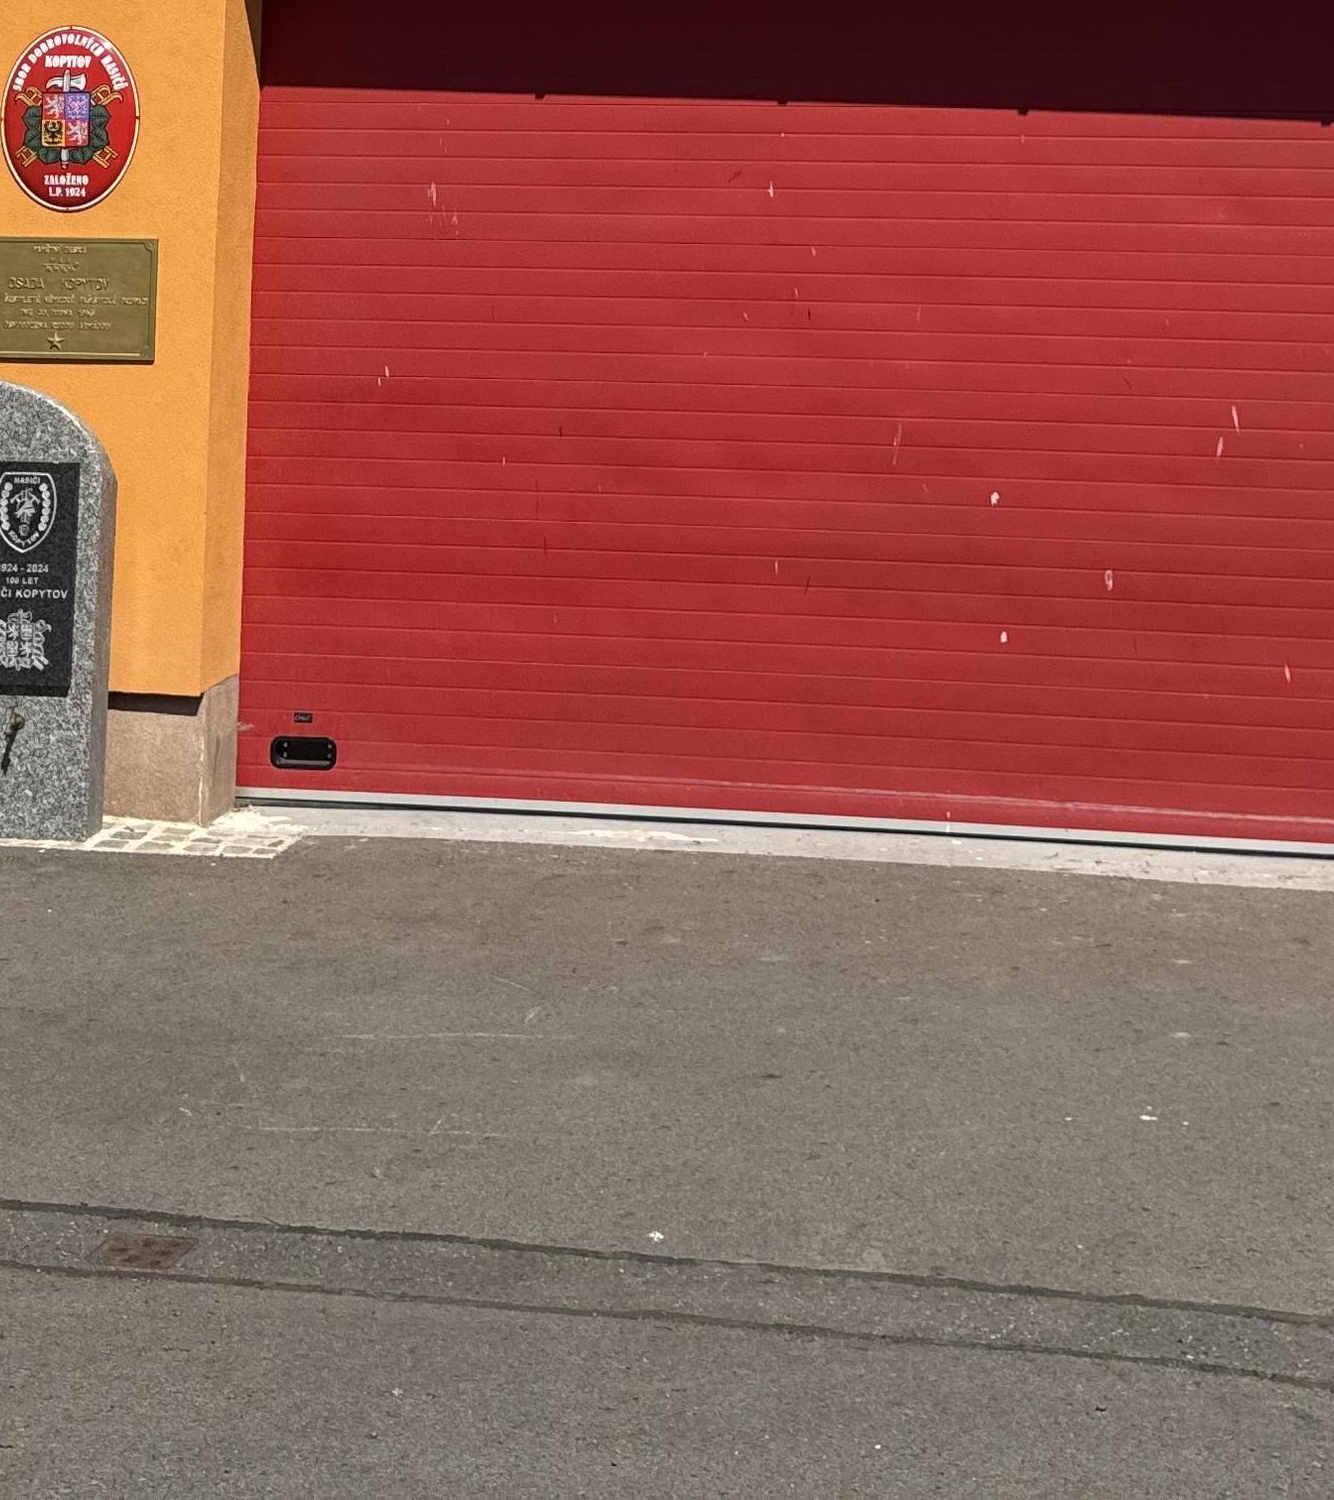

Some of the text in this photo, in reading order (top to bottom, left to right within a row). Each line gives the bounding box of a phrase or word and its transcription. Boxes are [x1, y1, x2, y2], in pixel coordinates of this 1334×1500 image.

[44, 173, 89, 186] ZALOŽENO
[66, 188, 86, 197] 1924
[27, 563, 49, 573] 2024
[22, 577, 39, 585] LET
[15, 589, 68, 599] KOPYTOV
